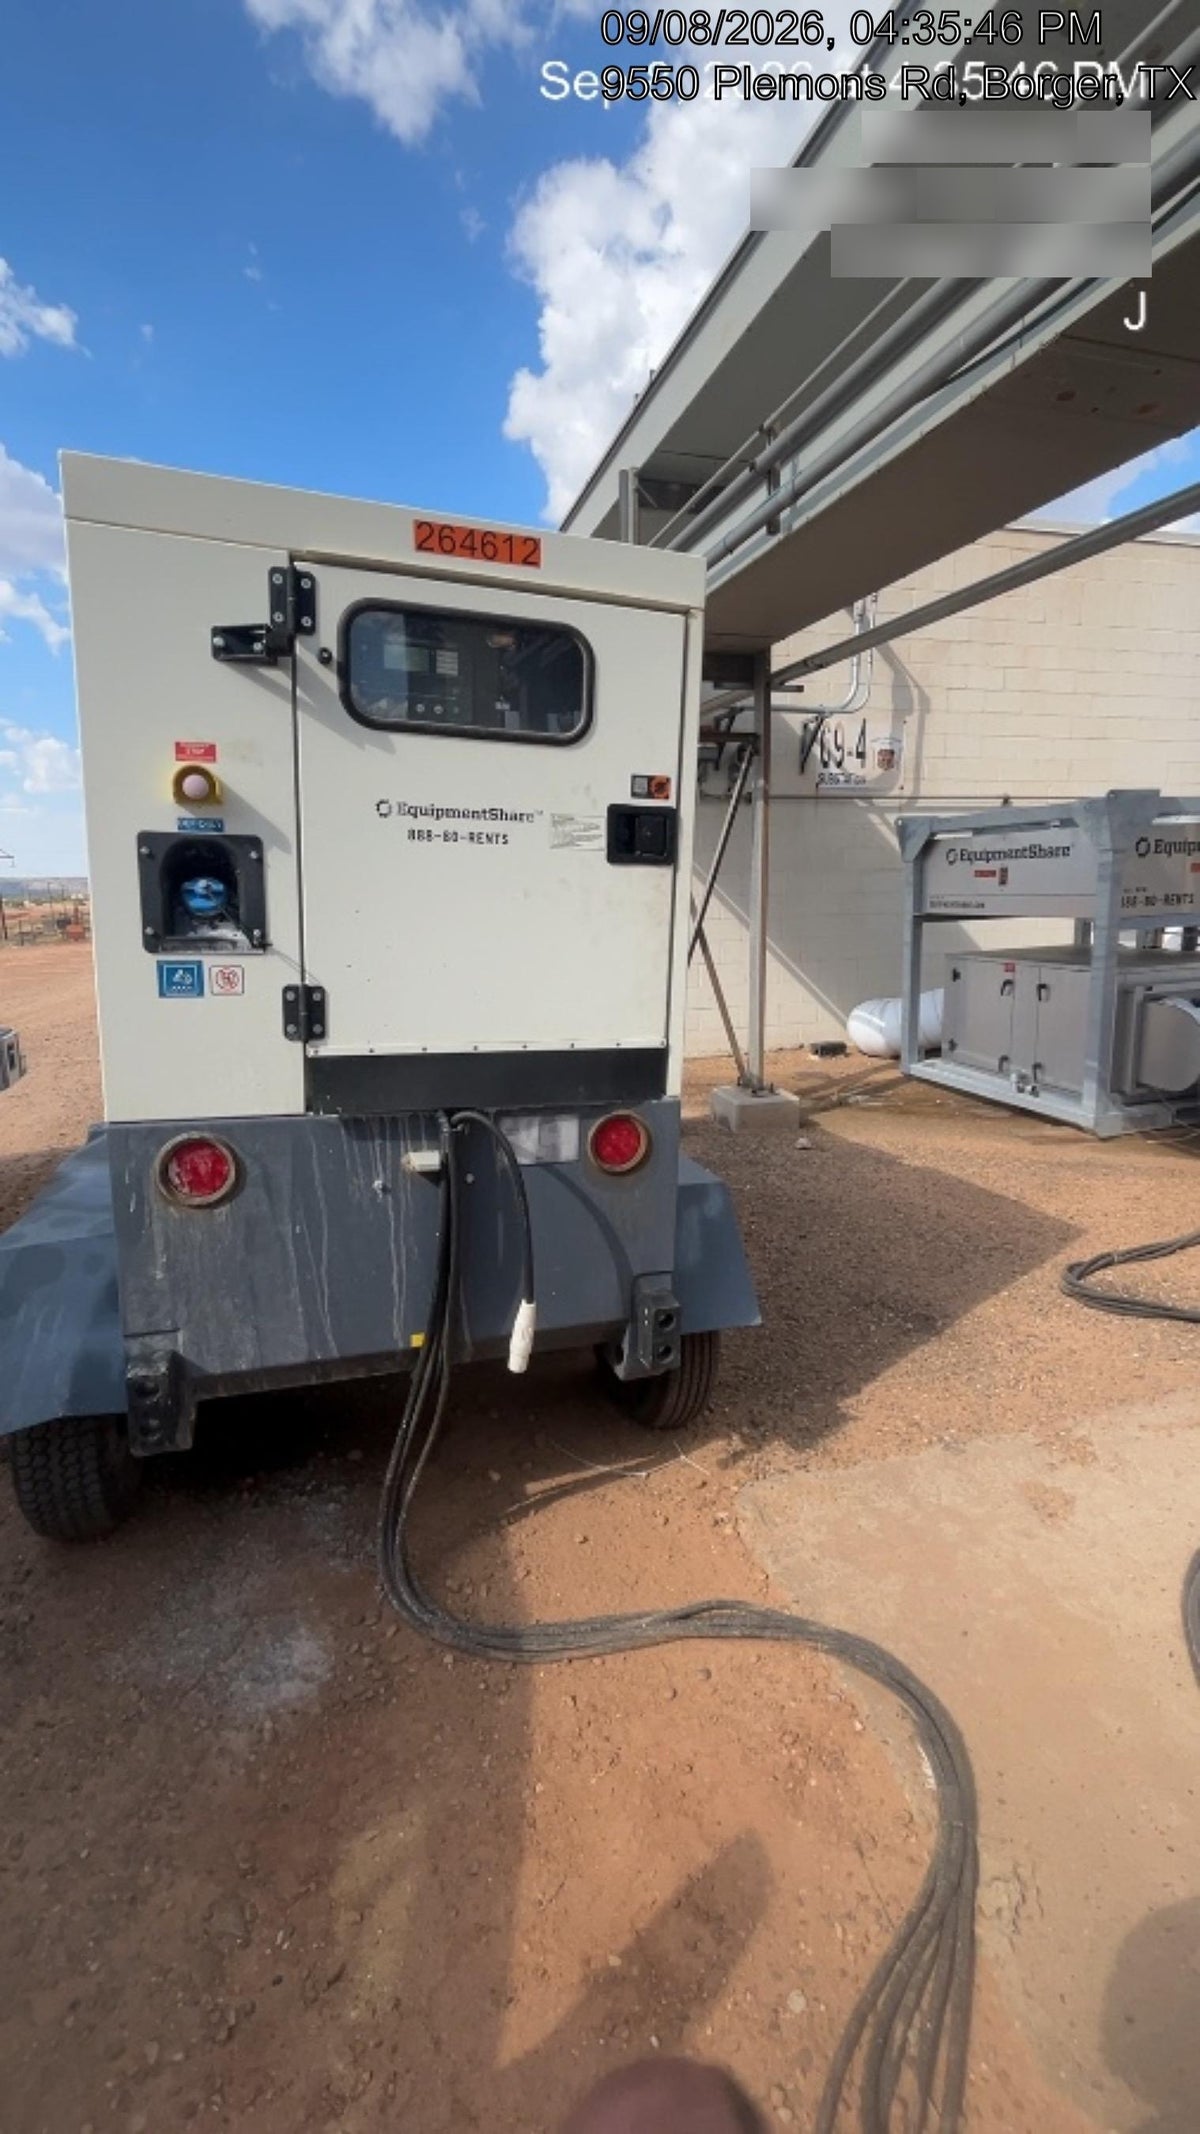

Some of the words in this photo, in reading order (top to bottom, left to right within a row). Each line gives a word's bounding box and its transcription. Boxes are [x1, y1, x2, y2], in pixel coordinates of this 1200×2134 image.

[416, 521, 540, 565] 264612
[397, 801, 535, 823] EquipmentShare
[960, 843, 1071, 865] EquipmentShare
[1153, 837, 1200, 858] Equip
